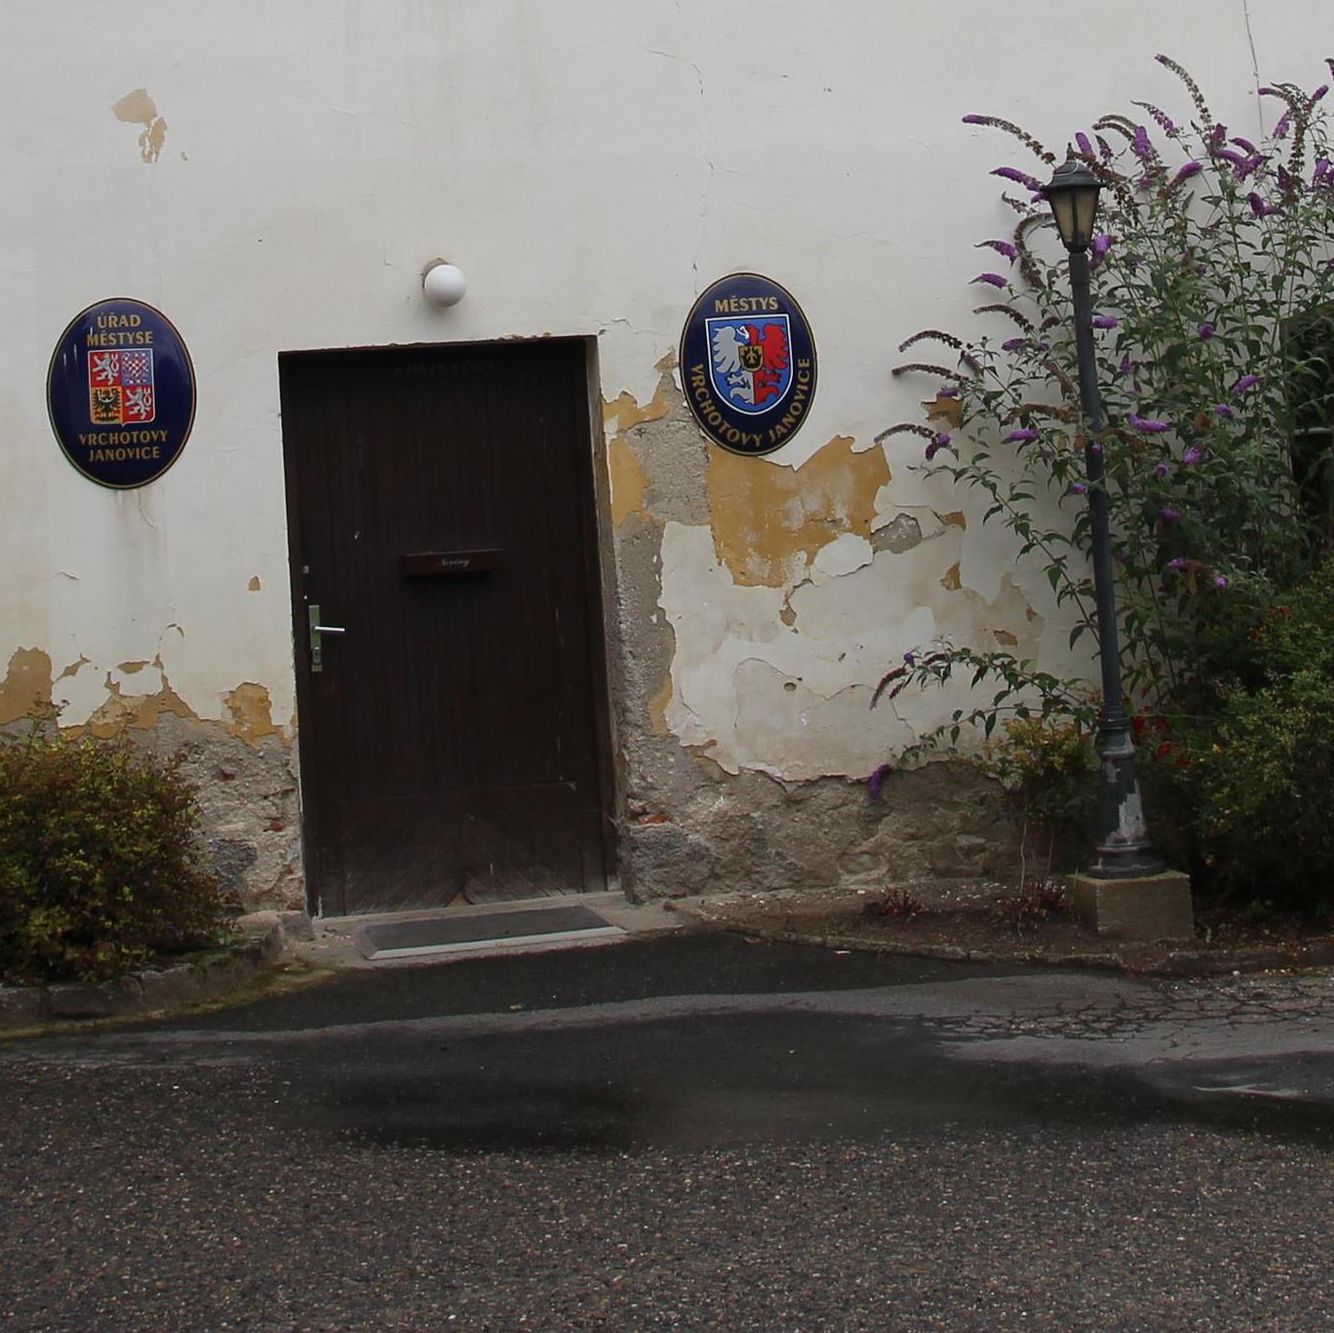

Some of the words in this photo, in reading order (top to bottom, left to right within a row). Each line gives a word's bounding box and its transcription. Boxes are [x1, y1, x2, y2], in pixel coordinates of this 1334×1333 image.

[714, 295, 779, 314] MĚSTYS
[97, 312, 142, 328] ÚŘAD
[86, 330, 154, 347] MĚSTYSE
[690, 363, 763, 448] VRCHOTOVY
[768, 357, 811, 444] JANOVICE
[78, 429, 169, 447] VRCHOTOVY
[87, 446, 161, 463] JANOVICE
